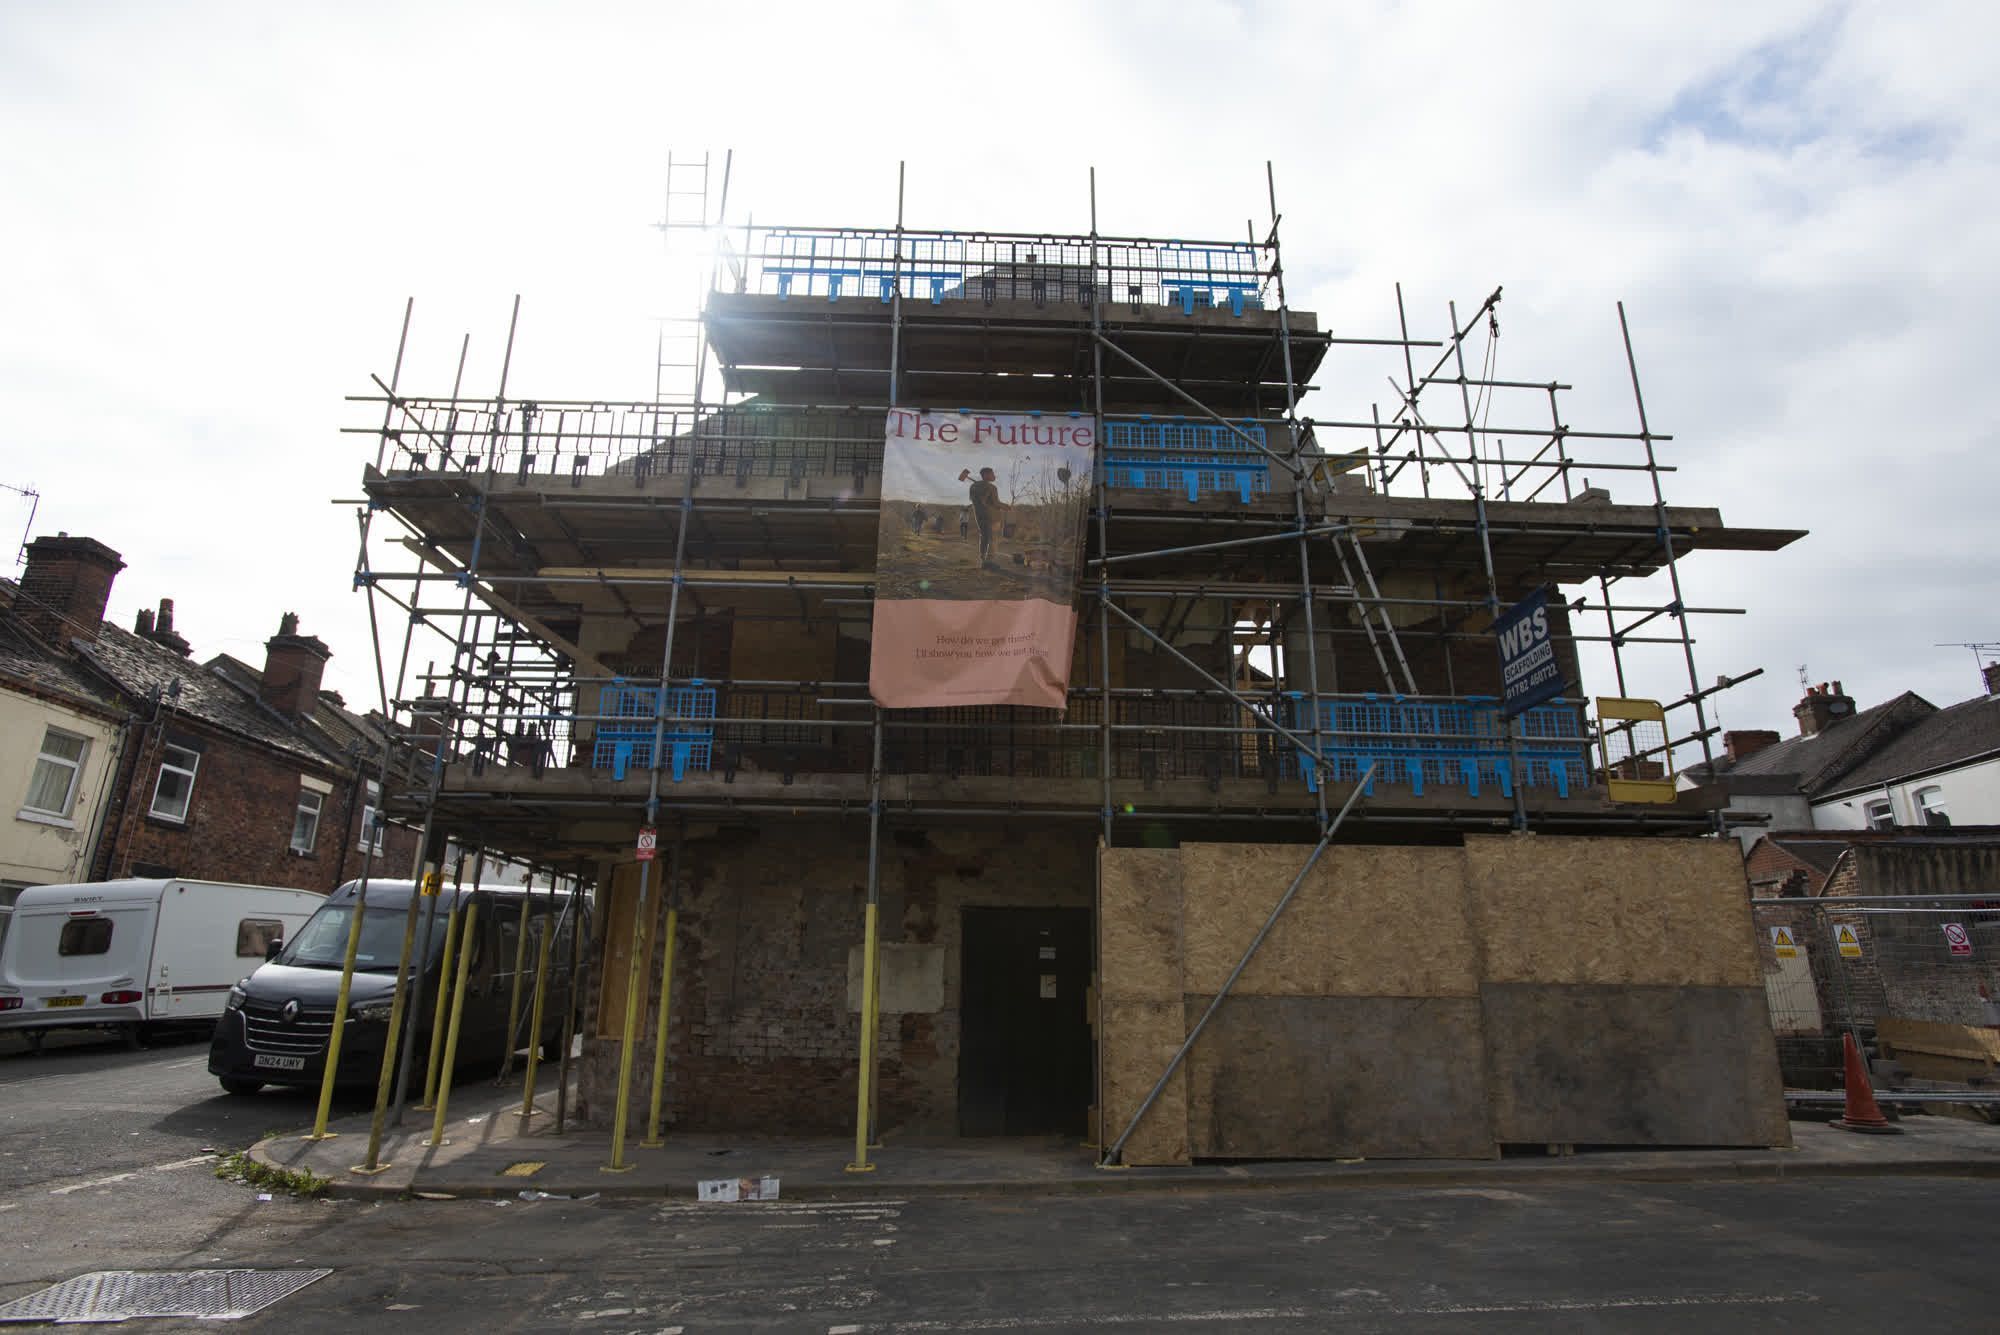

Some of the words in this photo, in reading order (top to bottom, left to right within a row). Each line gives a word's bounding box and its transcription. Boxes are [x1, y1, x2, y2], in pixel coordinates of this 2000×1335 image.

[891, 410, 959, 443] The
[972, 416, 1093, 447] Future
[936, 634, 960, 645] How
[961, 633, 974, 645] do
[975, 637, 990, 645] we
[1499, 606, 1548, 661] WBS
[928, 647, 953, 657] show
[954, 648, 972, 660] you
[1505, 643, 1552, 681] SCAFFOLDING
[1506, 679, 1530, 700] 01782
